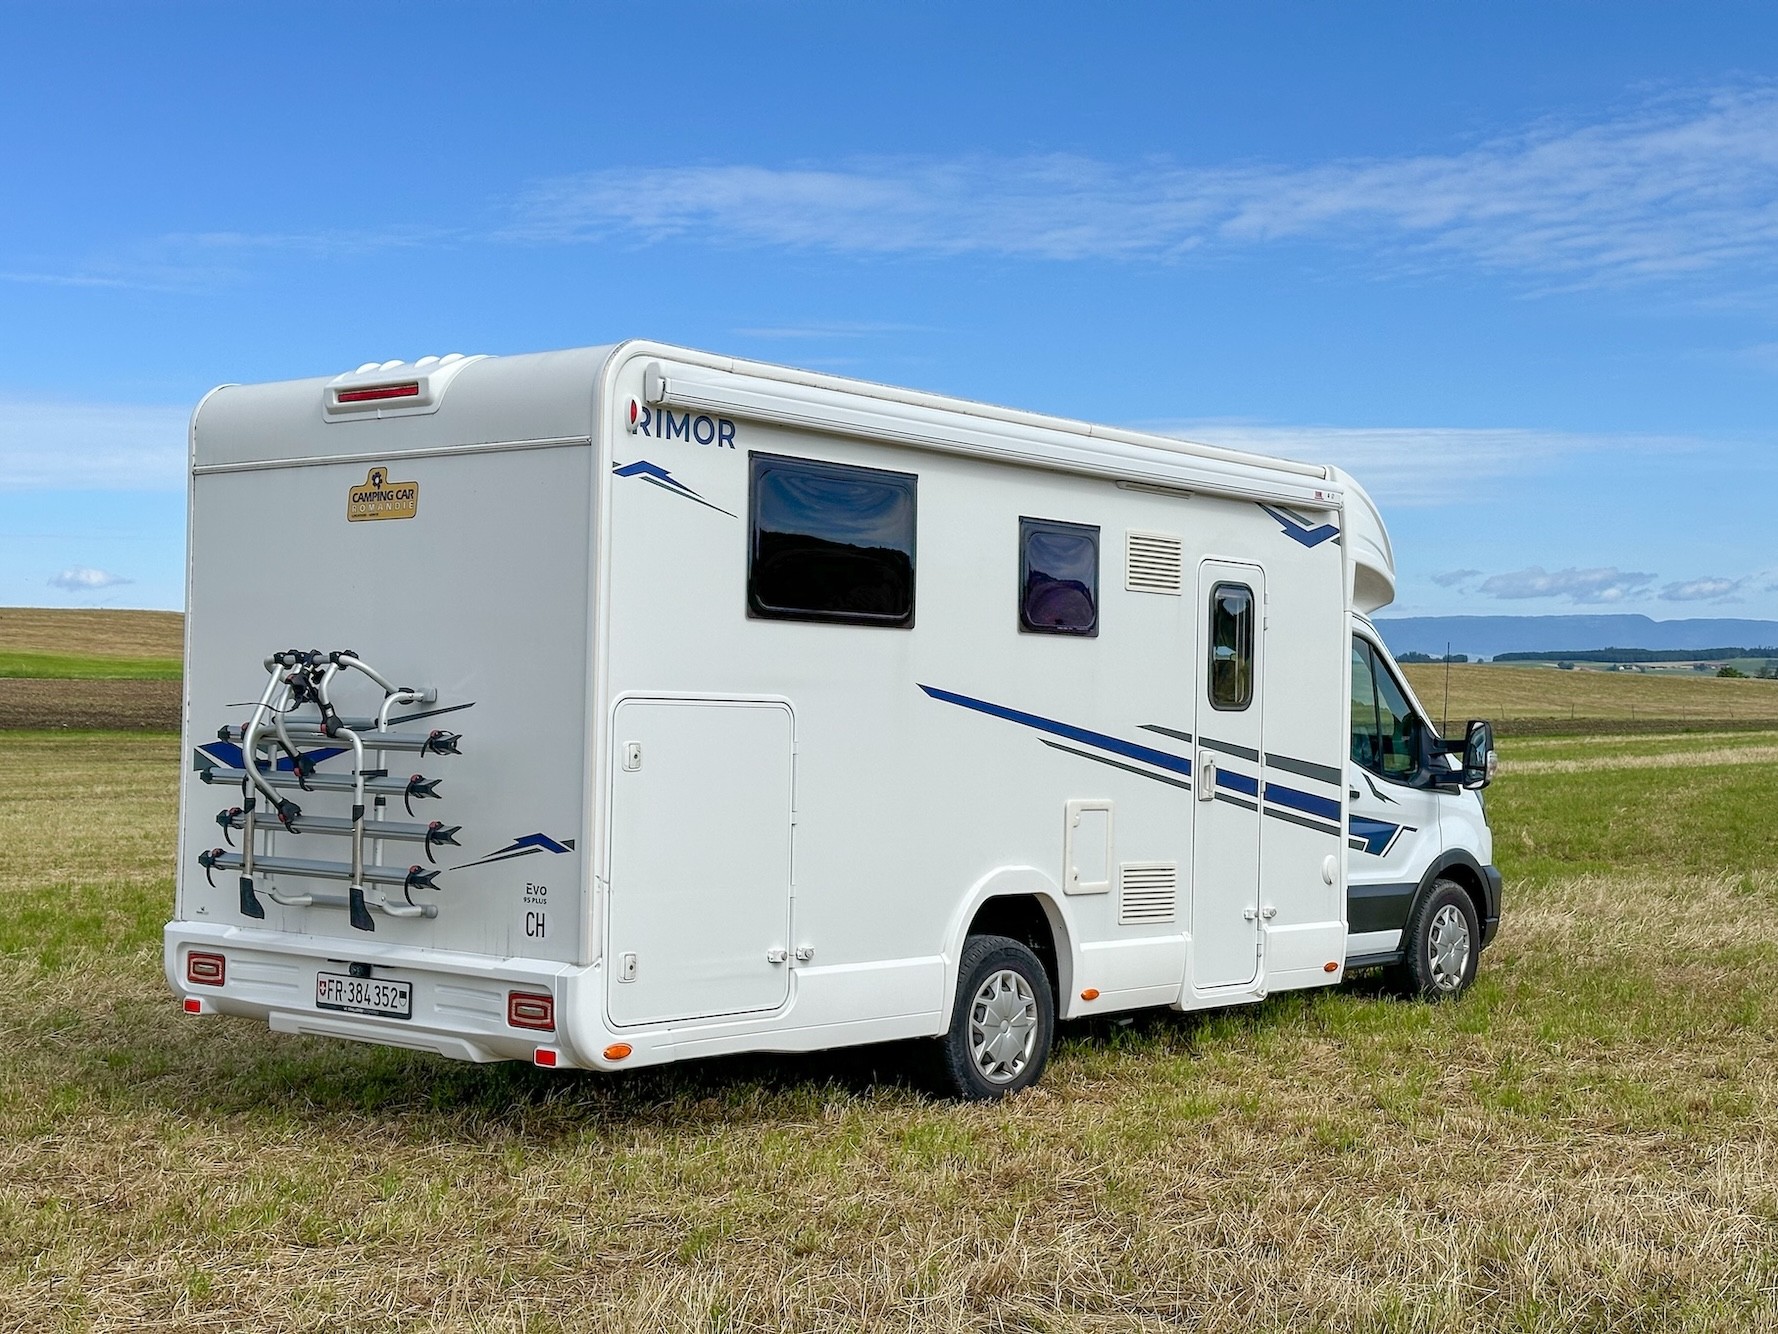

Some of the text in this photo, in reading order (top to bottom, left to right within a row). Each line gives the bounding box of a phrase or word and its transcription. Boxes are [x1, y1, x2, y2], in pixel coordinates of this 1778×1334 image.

[632, 406, 736, 449] RIMOR
[352, 489, 414, 503] CAMPING CAR
[351, 500, 414, 513] ROMANDIE
[531, 897, 547, 905] PLUS
[526, 911, 545, 938] CH
[373, 985, 398, 1009] 352
